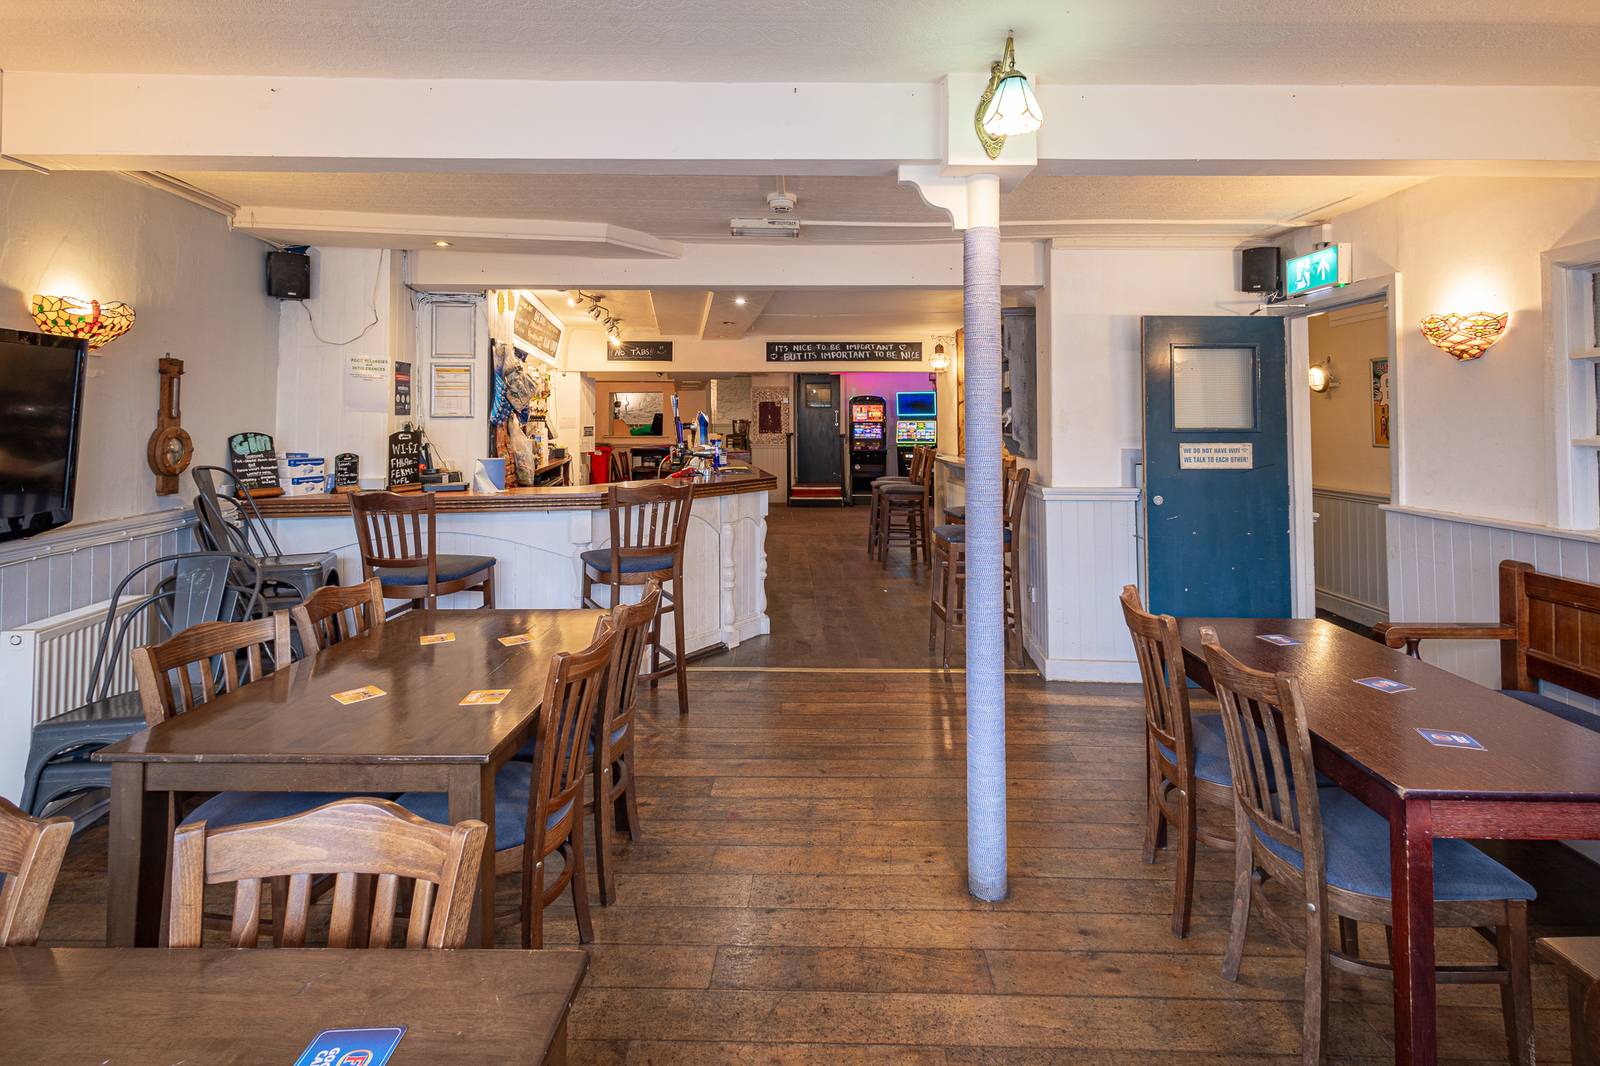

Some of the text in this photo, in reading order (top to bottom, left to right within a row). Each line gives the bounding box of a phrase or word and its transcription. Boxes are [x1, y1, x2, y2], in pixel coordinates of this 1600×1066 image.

[783, 352, 803, 361] BUT
[820, 351, 871, 360] IMPORTANT
[901, 351, 921, 361] NICE
[231, 432, 272, 455] Gin
